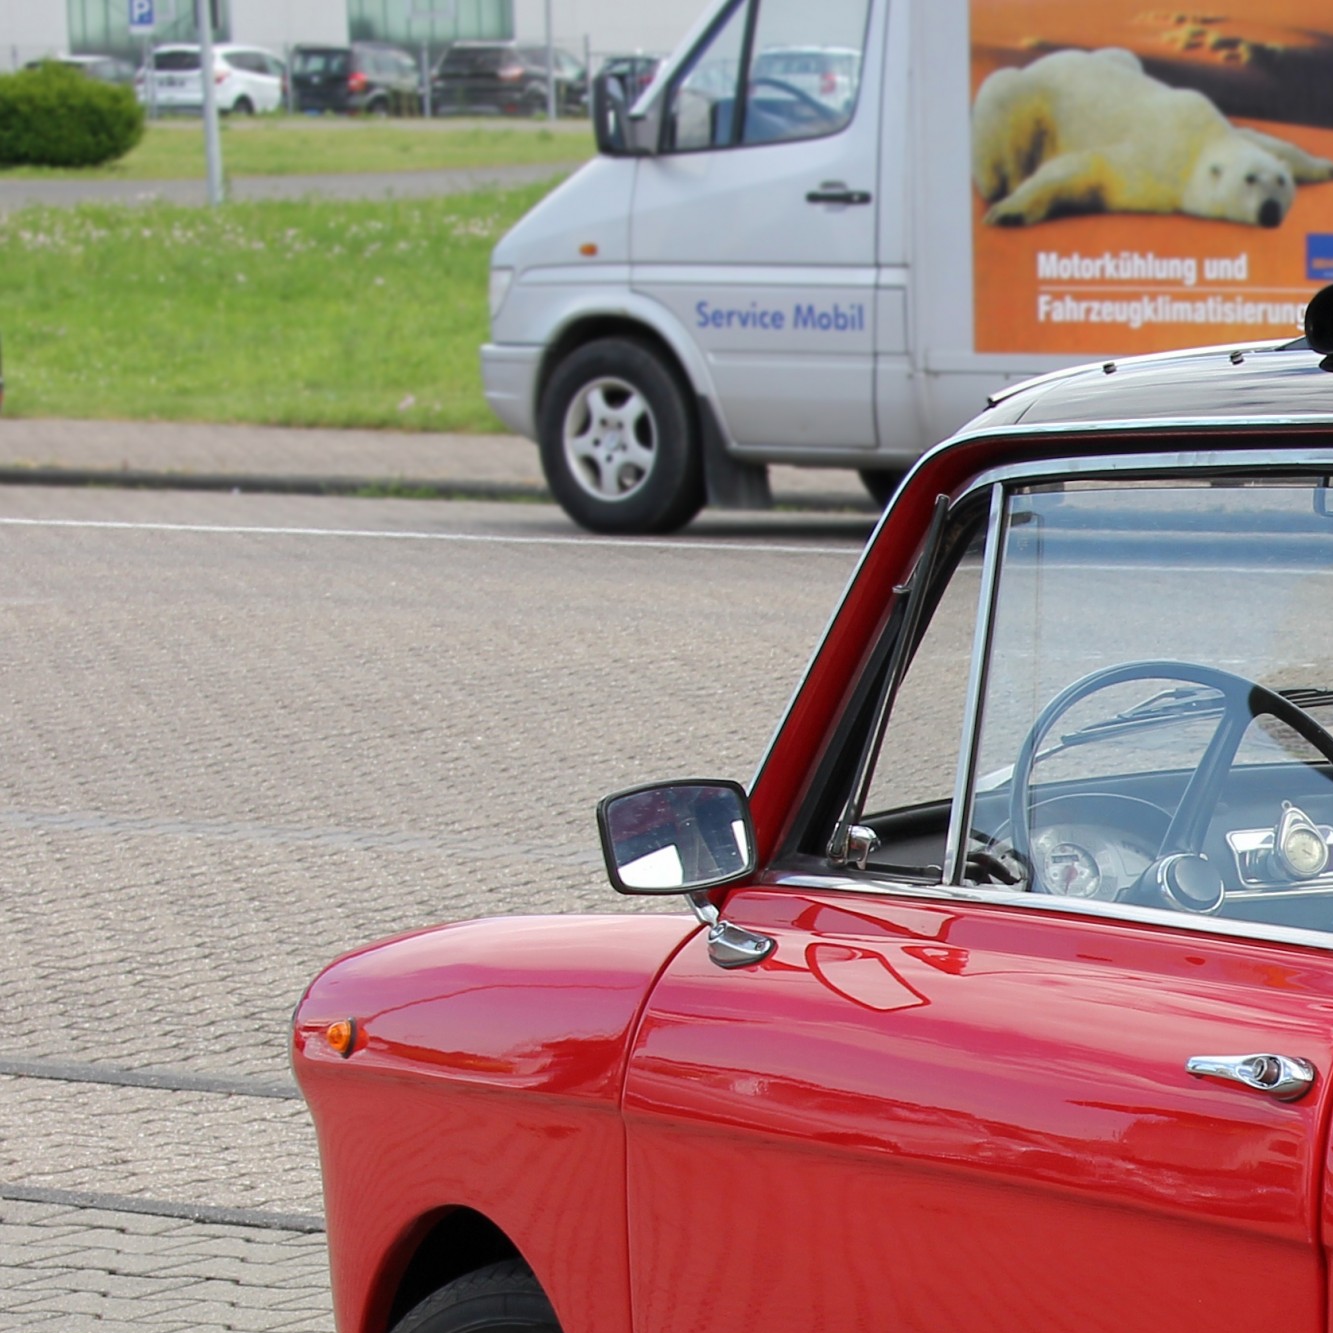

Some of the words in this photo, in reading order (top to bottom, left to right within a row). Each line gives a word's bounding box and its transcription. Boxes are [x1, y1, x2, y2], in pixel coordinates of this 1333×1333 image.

[1037, 252, 1197, 285] Motorkühlung
[1204, 254, 1248, 281] und
[696, 301, 785, 329] Service
[793, 303, 864, 331] Mobil
[1037, 296, 1306, 329] Fahrzeugklimatisierung
